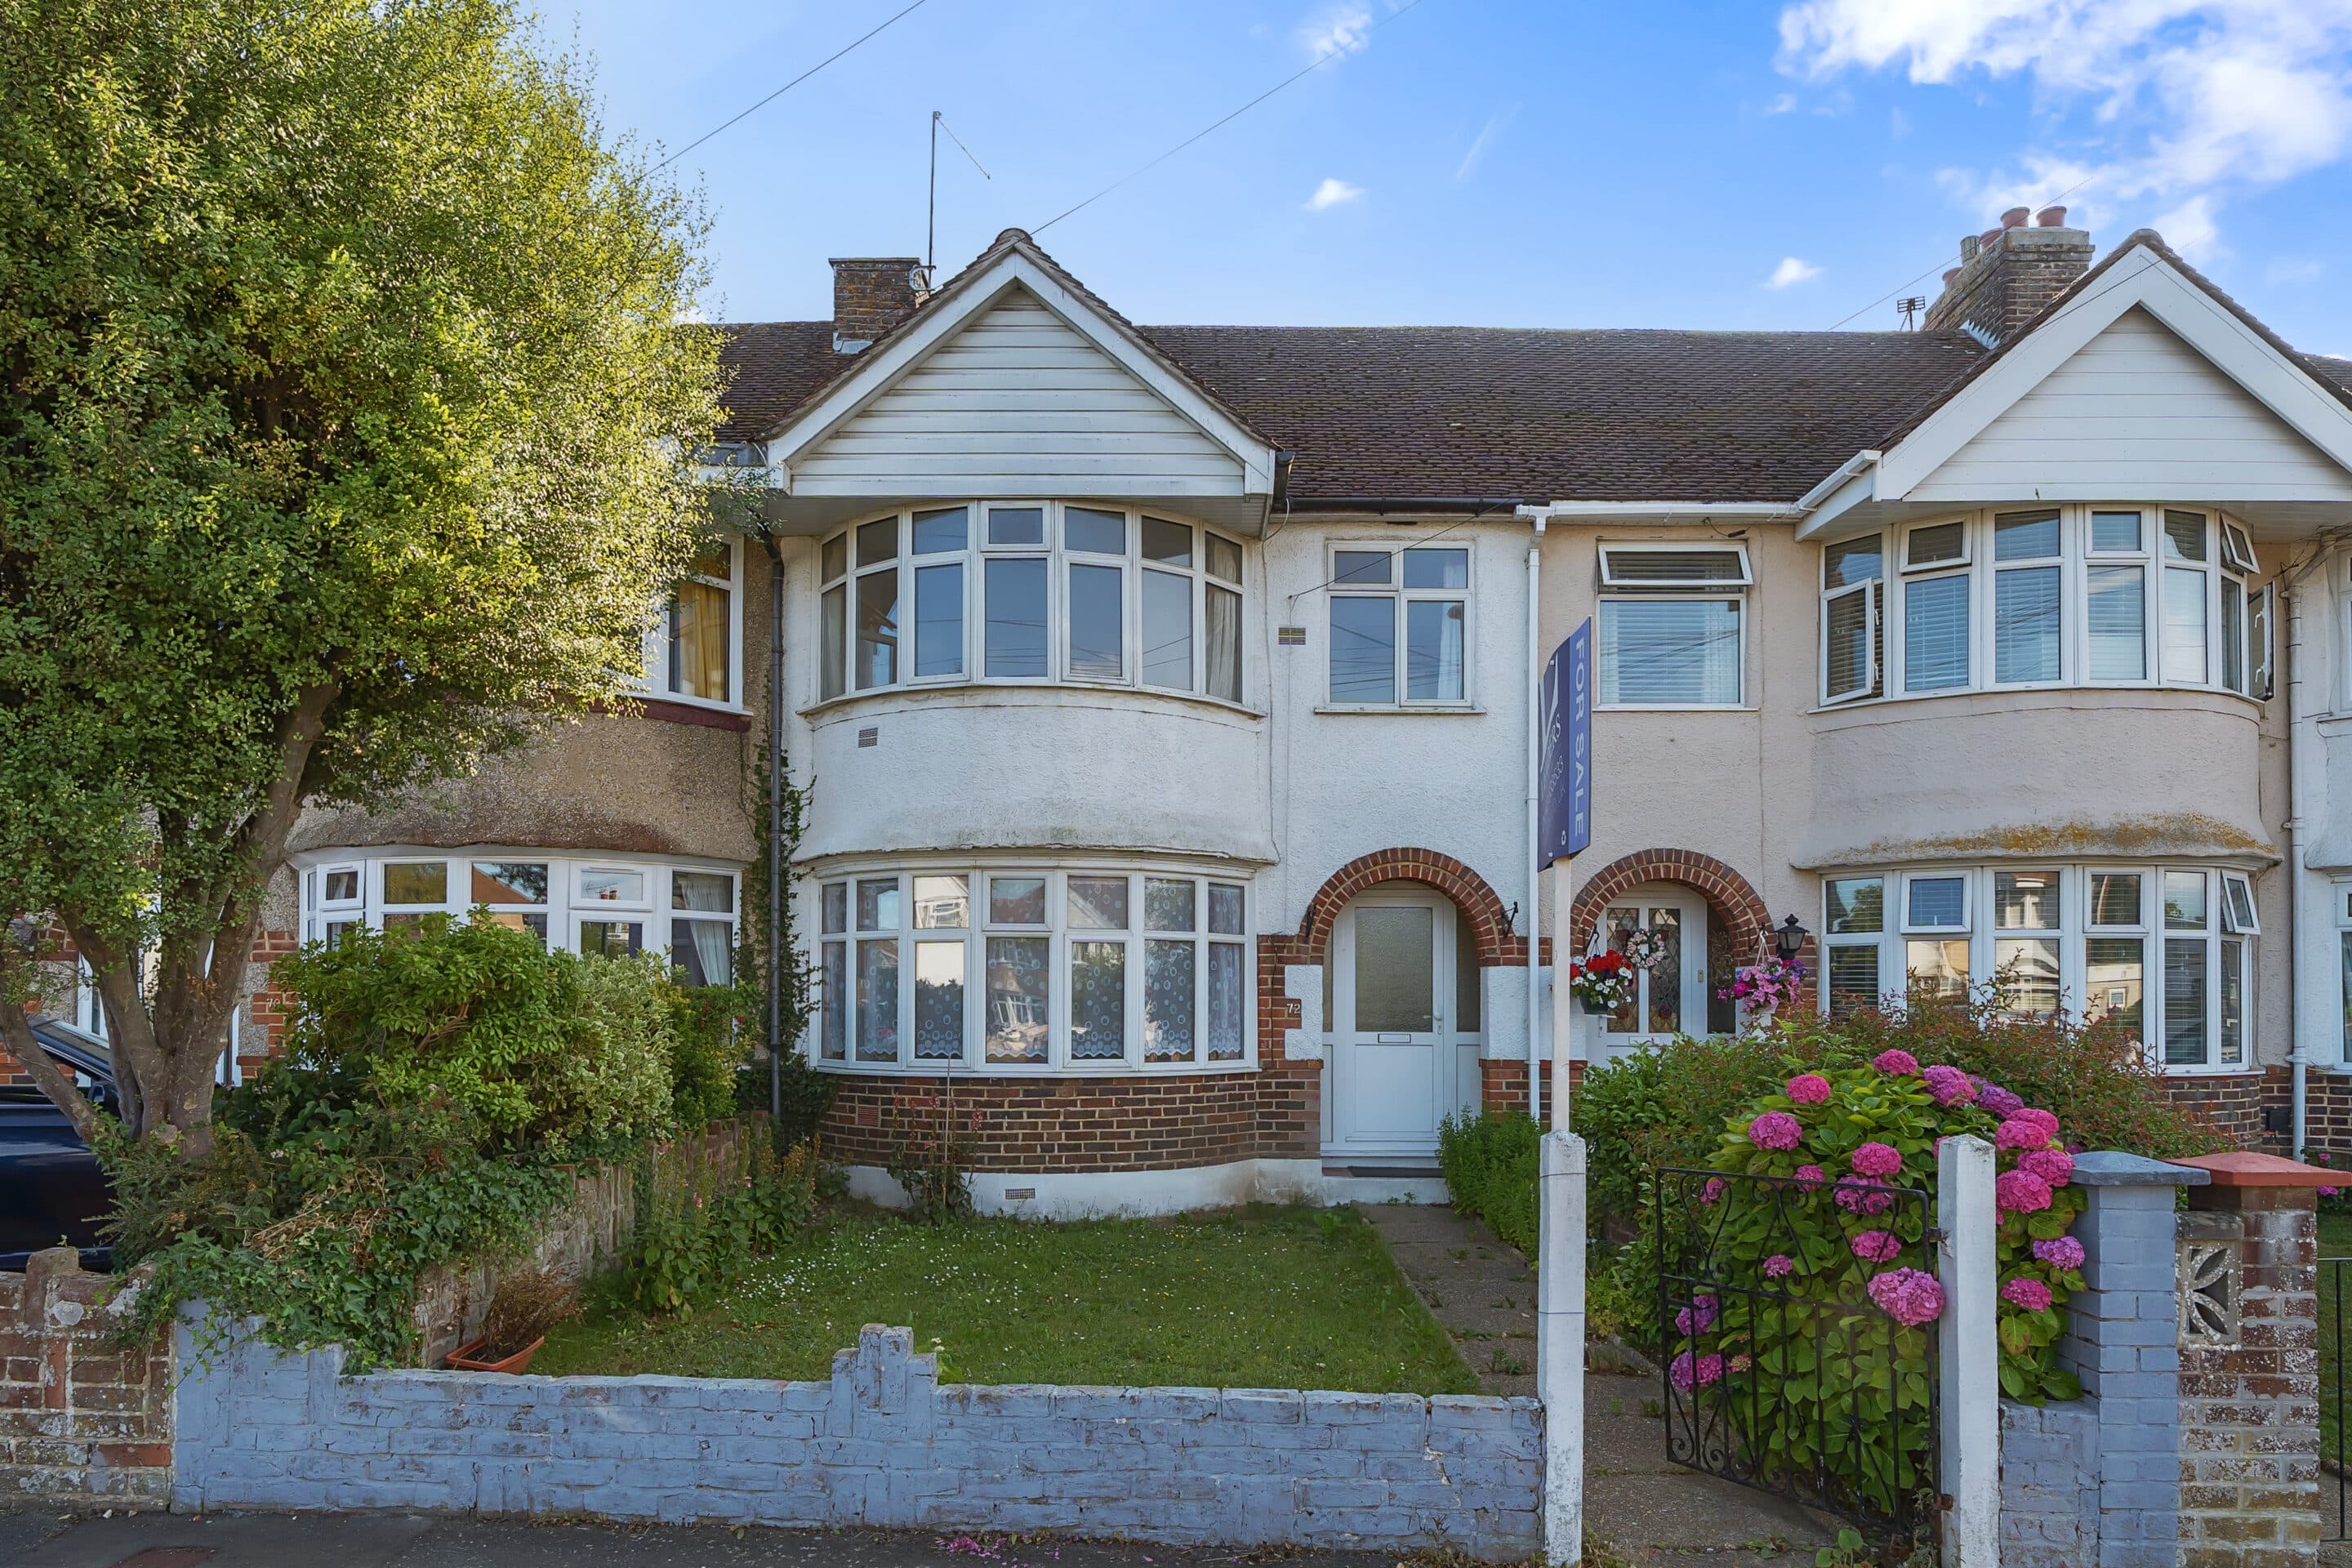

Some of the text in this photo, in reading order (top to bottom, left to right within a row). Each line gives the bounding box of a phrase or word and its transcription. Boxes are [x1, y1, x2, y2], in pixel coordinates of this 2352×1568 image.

[1575, 636, 1585, 837] FOR SALE
[1286, 1003, 1301, 1014] 72
